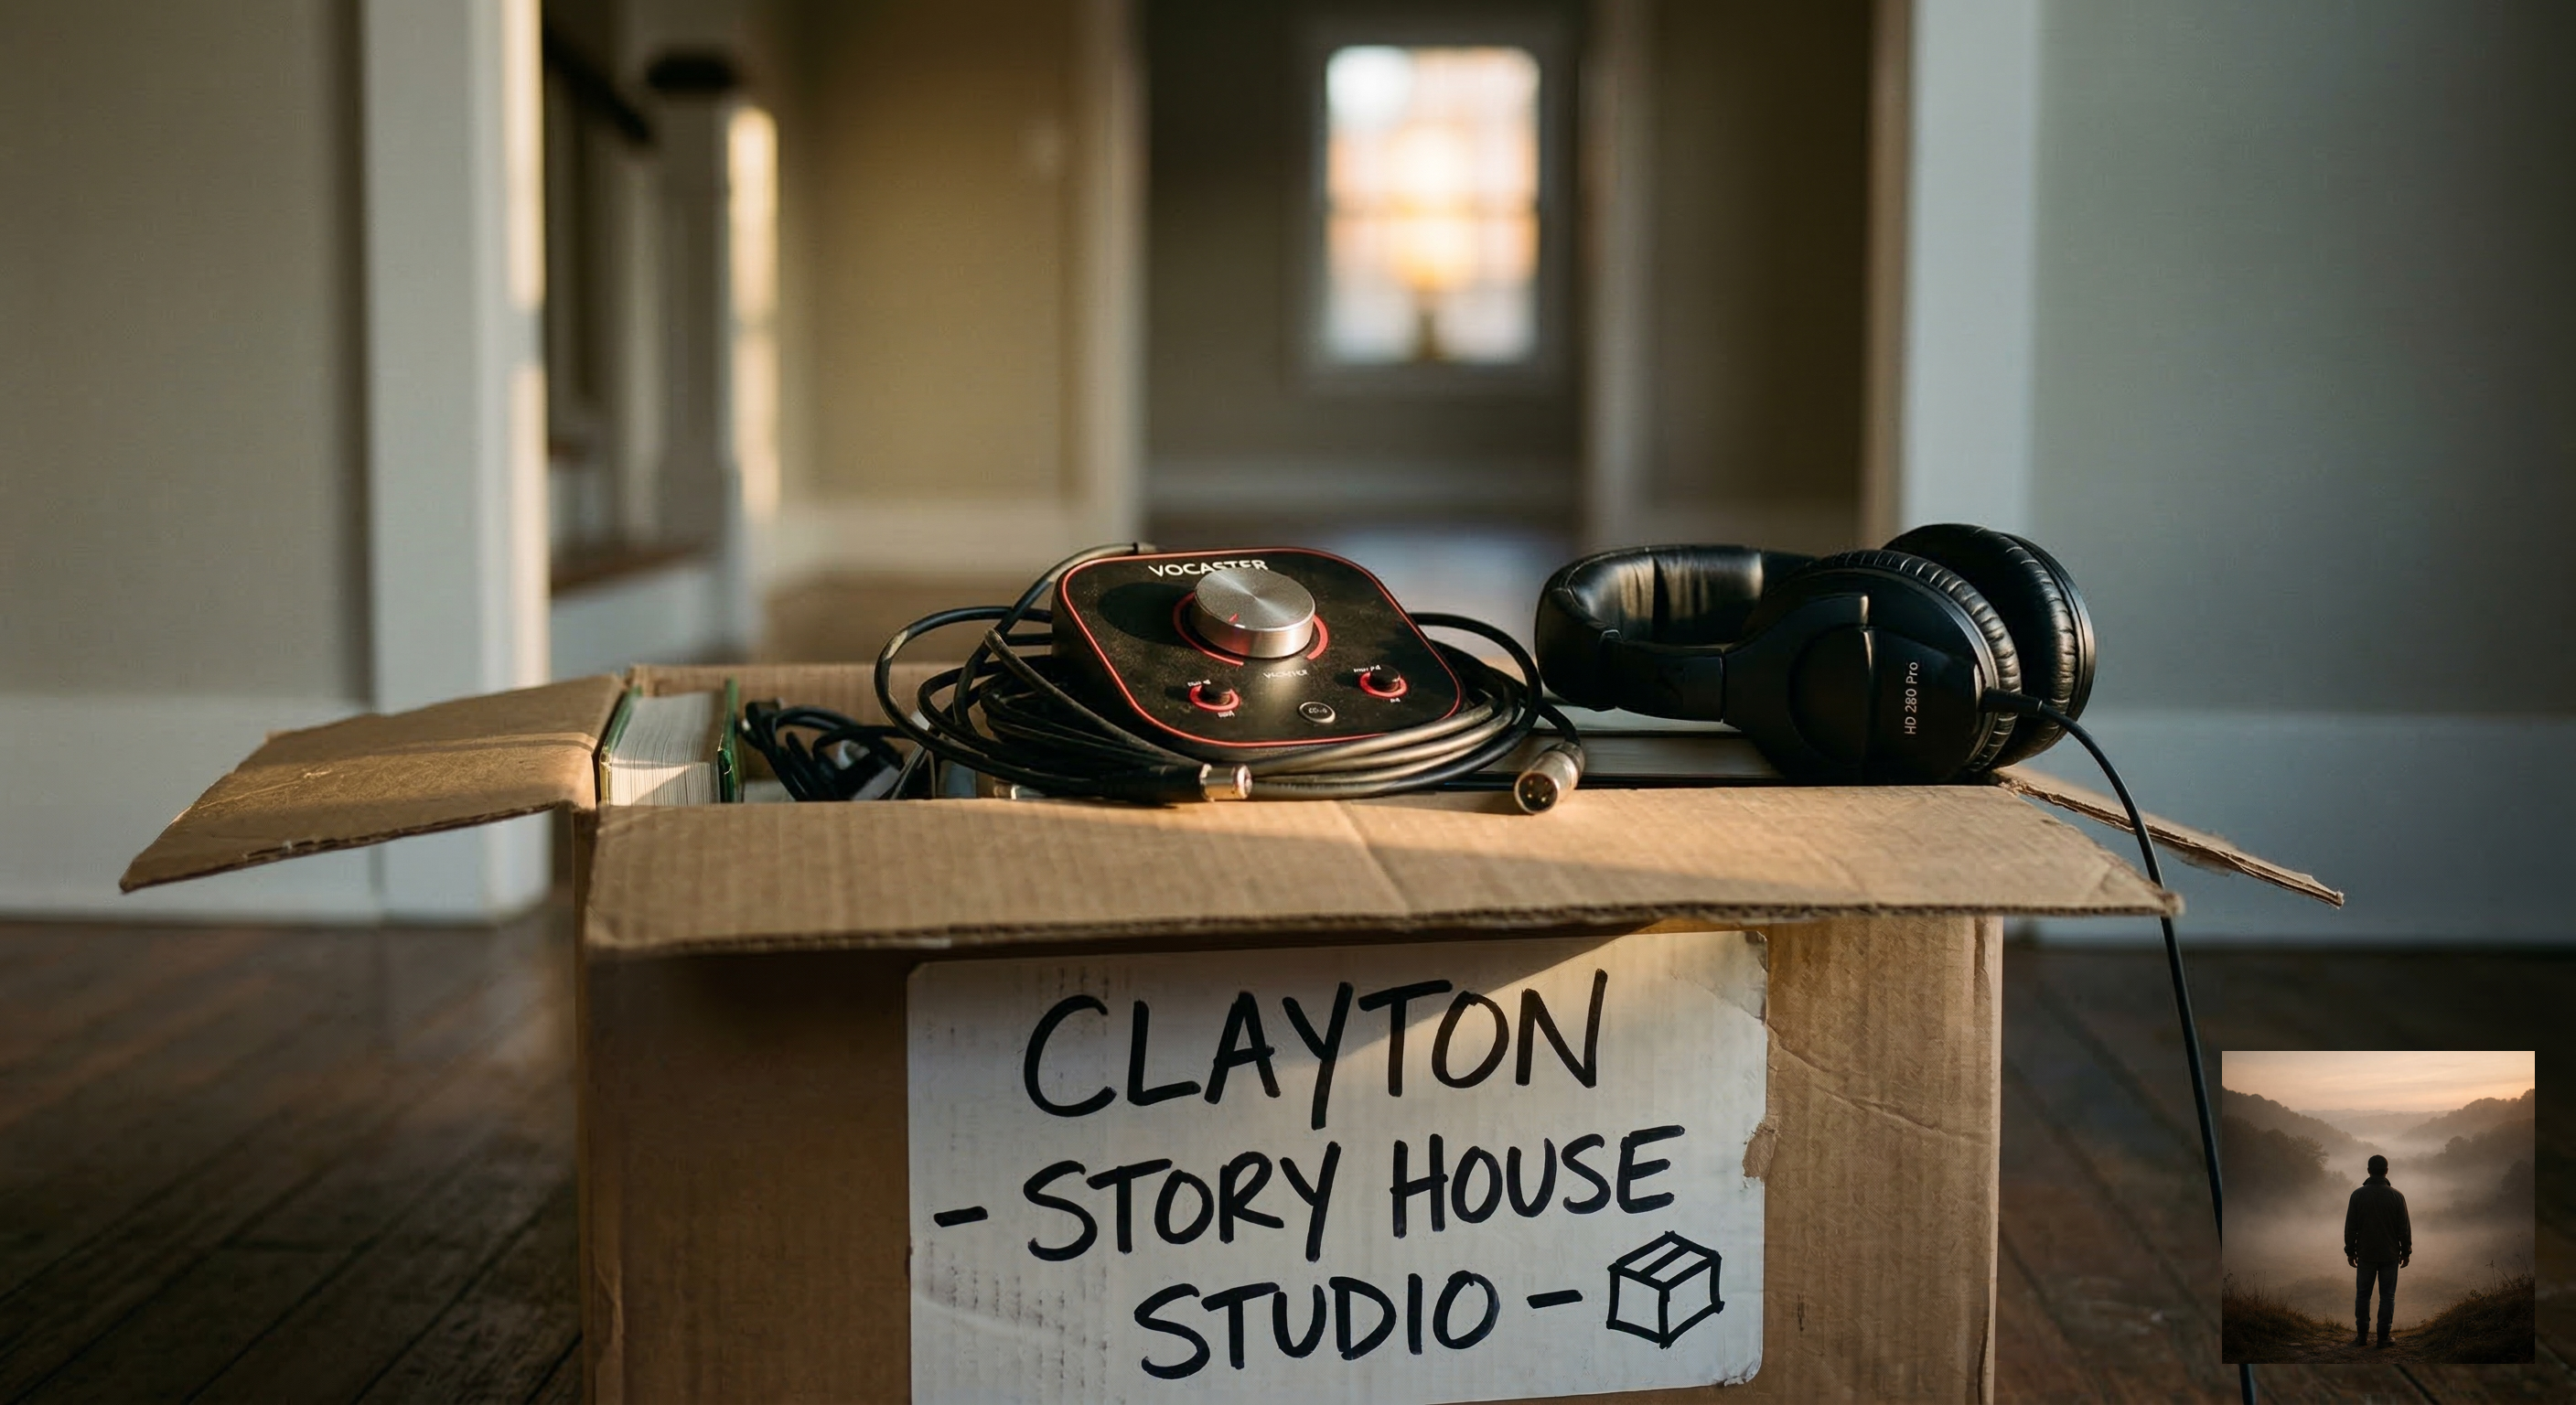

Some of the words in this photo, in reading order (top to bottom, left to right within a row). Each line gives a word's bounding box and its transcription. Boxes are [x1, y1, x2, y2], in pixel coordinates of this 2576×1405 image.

[1148, 559, 1269, 577] VOCASTER
[1905, 661, 1919, 684] Pro
[1905, 688, 1917, 713] 280
[1904, 716, 1917, 735] HD
[1023, 968, 1608, 1132] CLAYTON
[1023, 1141, 1342, 1263] STORY
[1390, 1124, 1687, 1239] HOUSE
[1133, 1270, 1501, 1380] STUDIO
